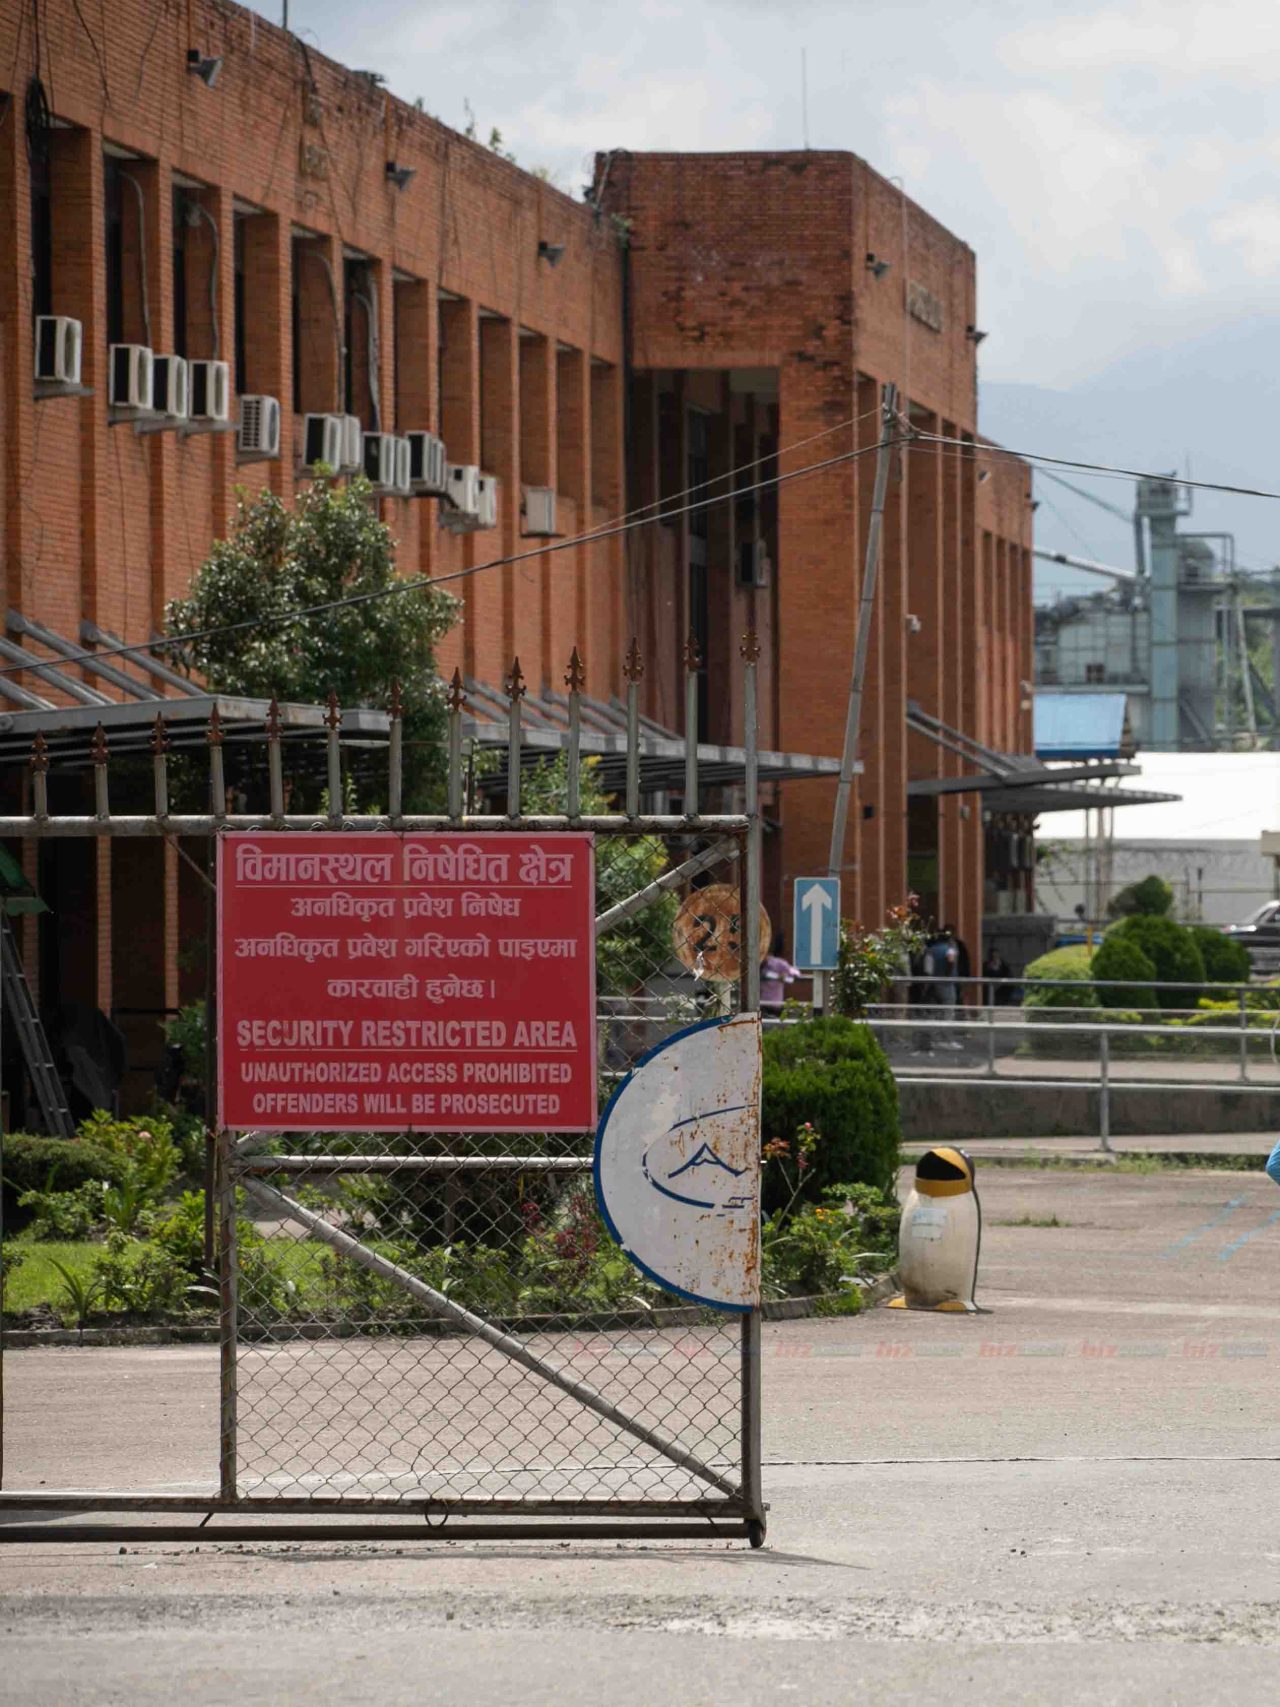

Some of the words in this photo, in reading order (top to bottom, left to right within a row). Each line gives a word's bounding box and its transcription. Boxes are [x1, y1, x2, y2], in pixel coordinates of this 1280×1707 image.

[236, 843, 394, 884] विमानस्थल
[519, 845, 574, 886] क्षेत्र
[403, 892, 454, 919] प्रवेश
[347, 933, 398, 959] प्रवेश
[405, 932, 491, 959] गरिएको
[498, 938, 577, 960] पाइएमा
[328, 973, 419, 1000] कारवाही
[238, 1020, 354, 1047] SECURITY
[362, 1020, 507, 1047] RESTRICTED
[513, 1020, 578, 1047] AREA
[241, 1062, 382, 1083] UNAUTHORIZED
[387, 1062, 457, 1083] ACCESS
[463, 1062, 572, 1083] PROHIBITED
[253, 1093, 359, 1114] OFFENDERS
[363, 1093, 407, 1114] WILL
[412, 1093, 435, 1114] BE
[440, 1093, 560, 1115] PROSECUTED
